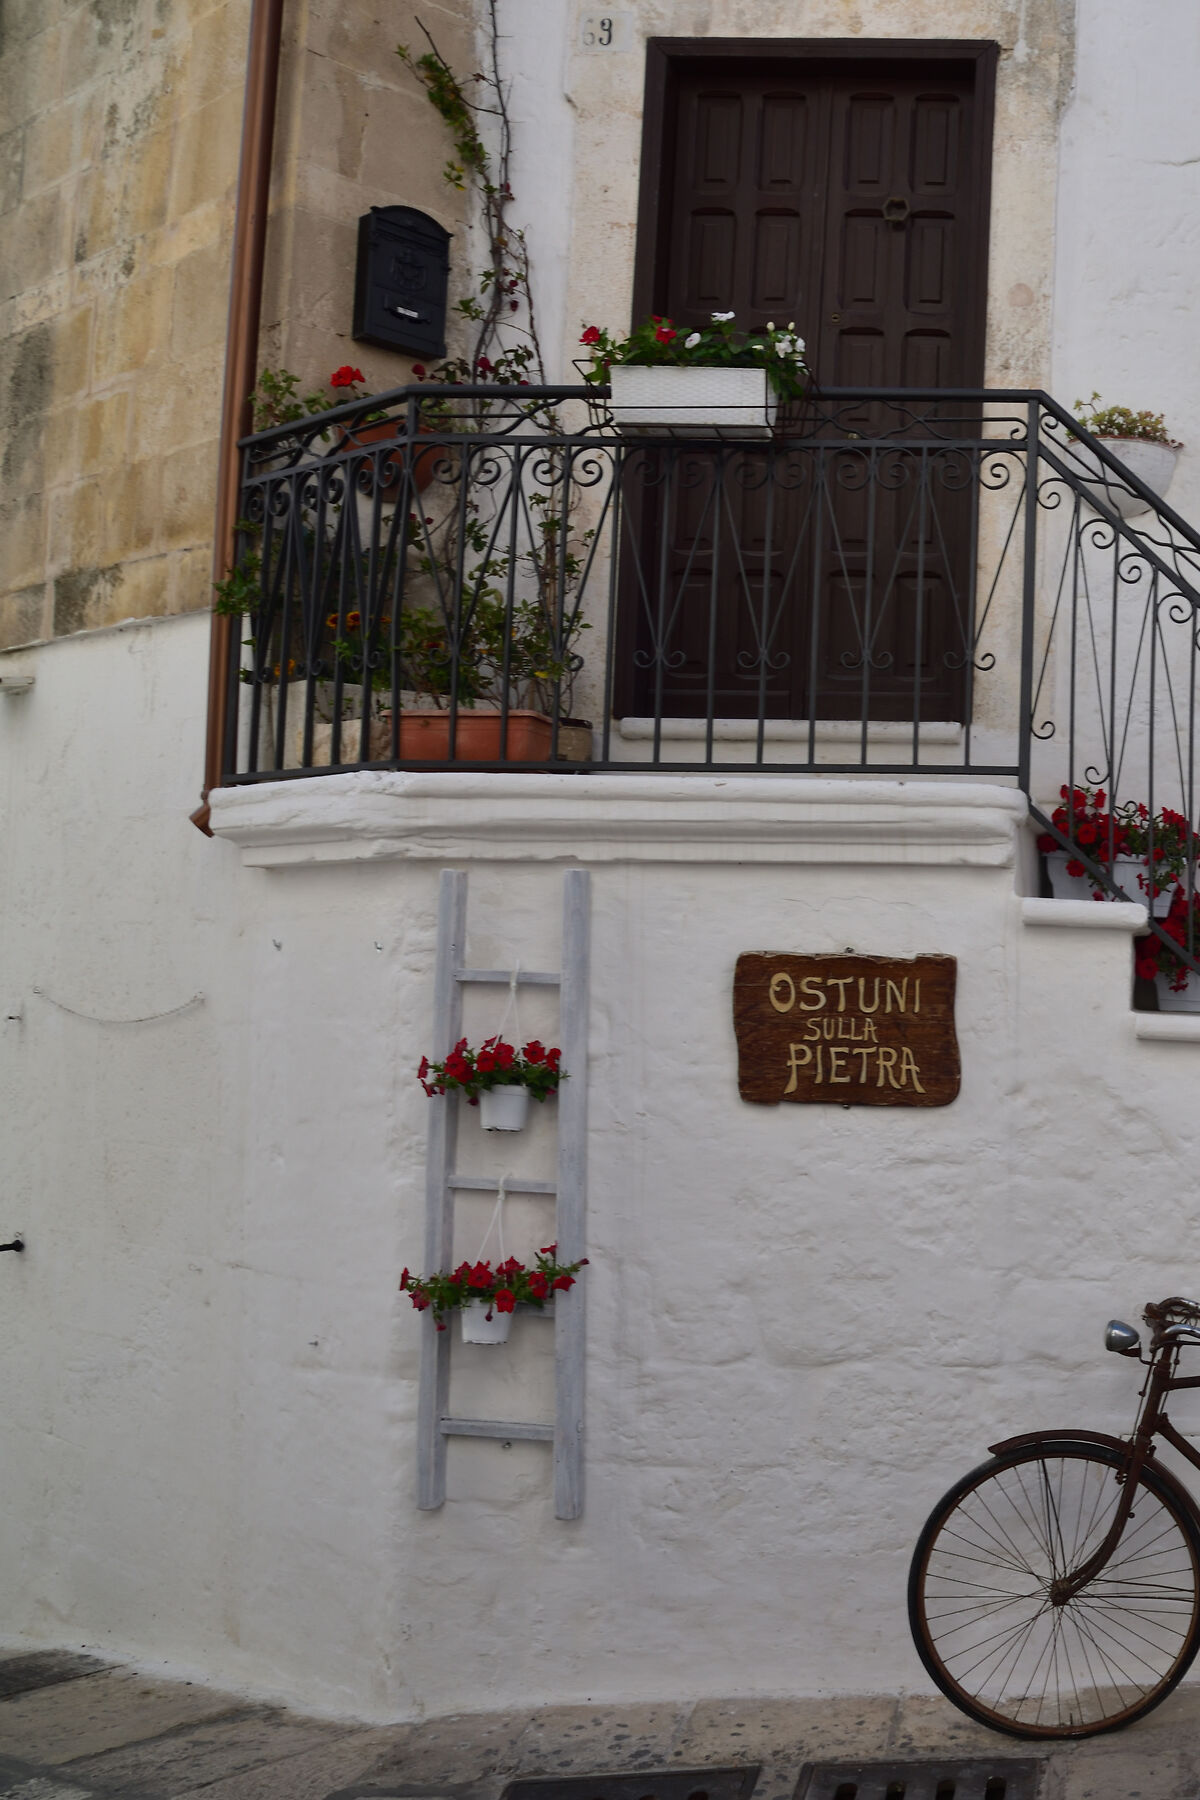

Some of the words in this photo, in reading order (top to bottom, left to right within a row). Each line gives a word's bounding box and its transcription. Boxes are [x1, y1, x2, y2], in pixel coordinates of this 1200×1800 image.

[768, 971, 922, 1014] OSTUNI
[802, 1016, 879, 1043] SULLA
[783, 1042, 927, 1094] PIETRA
